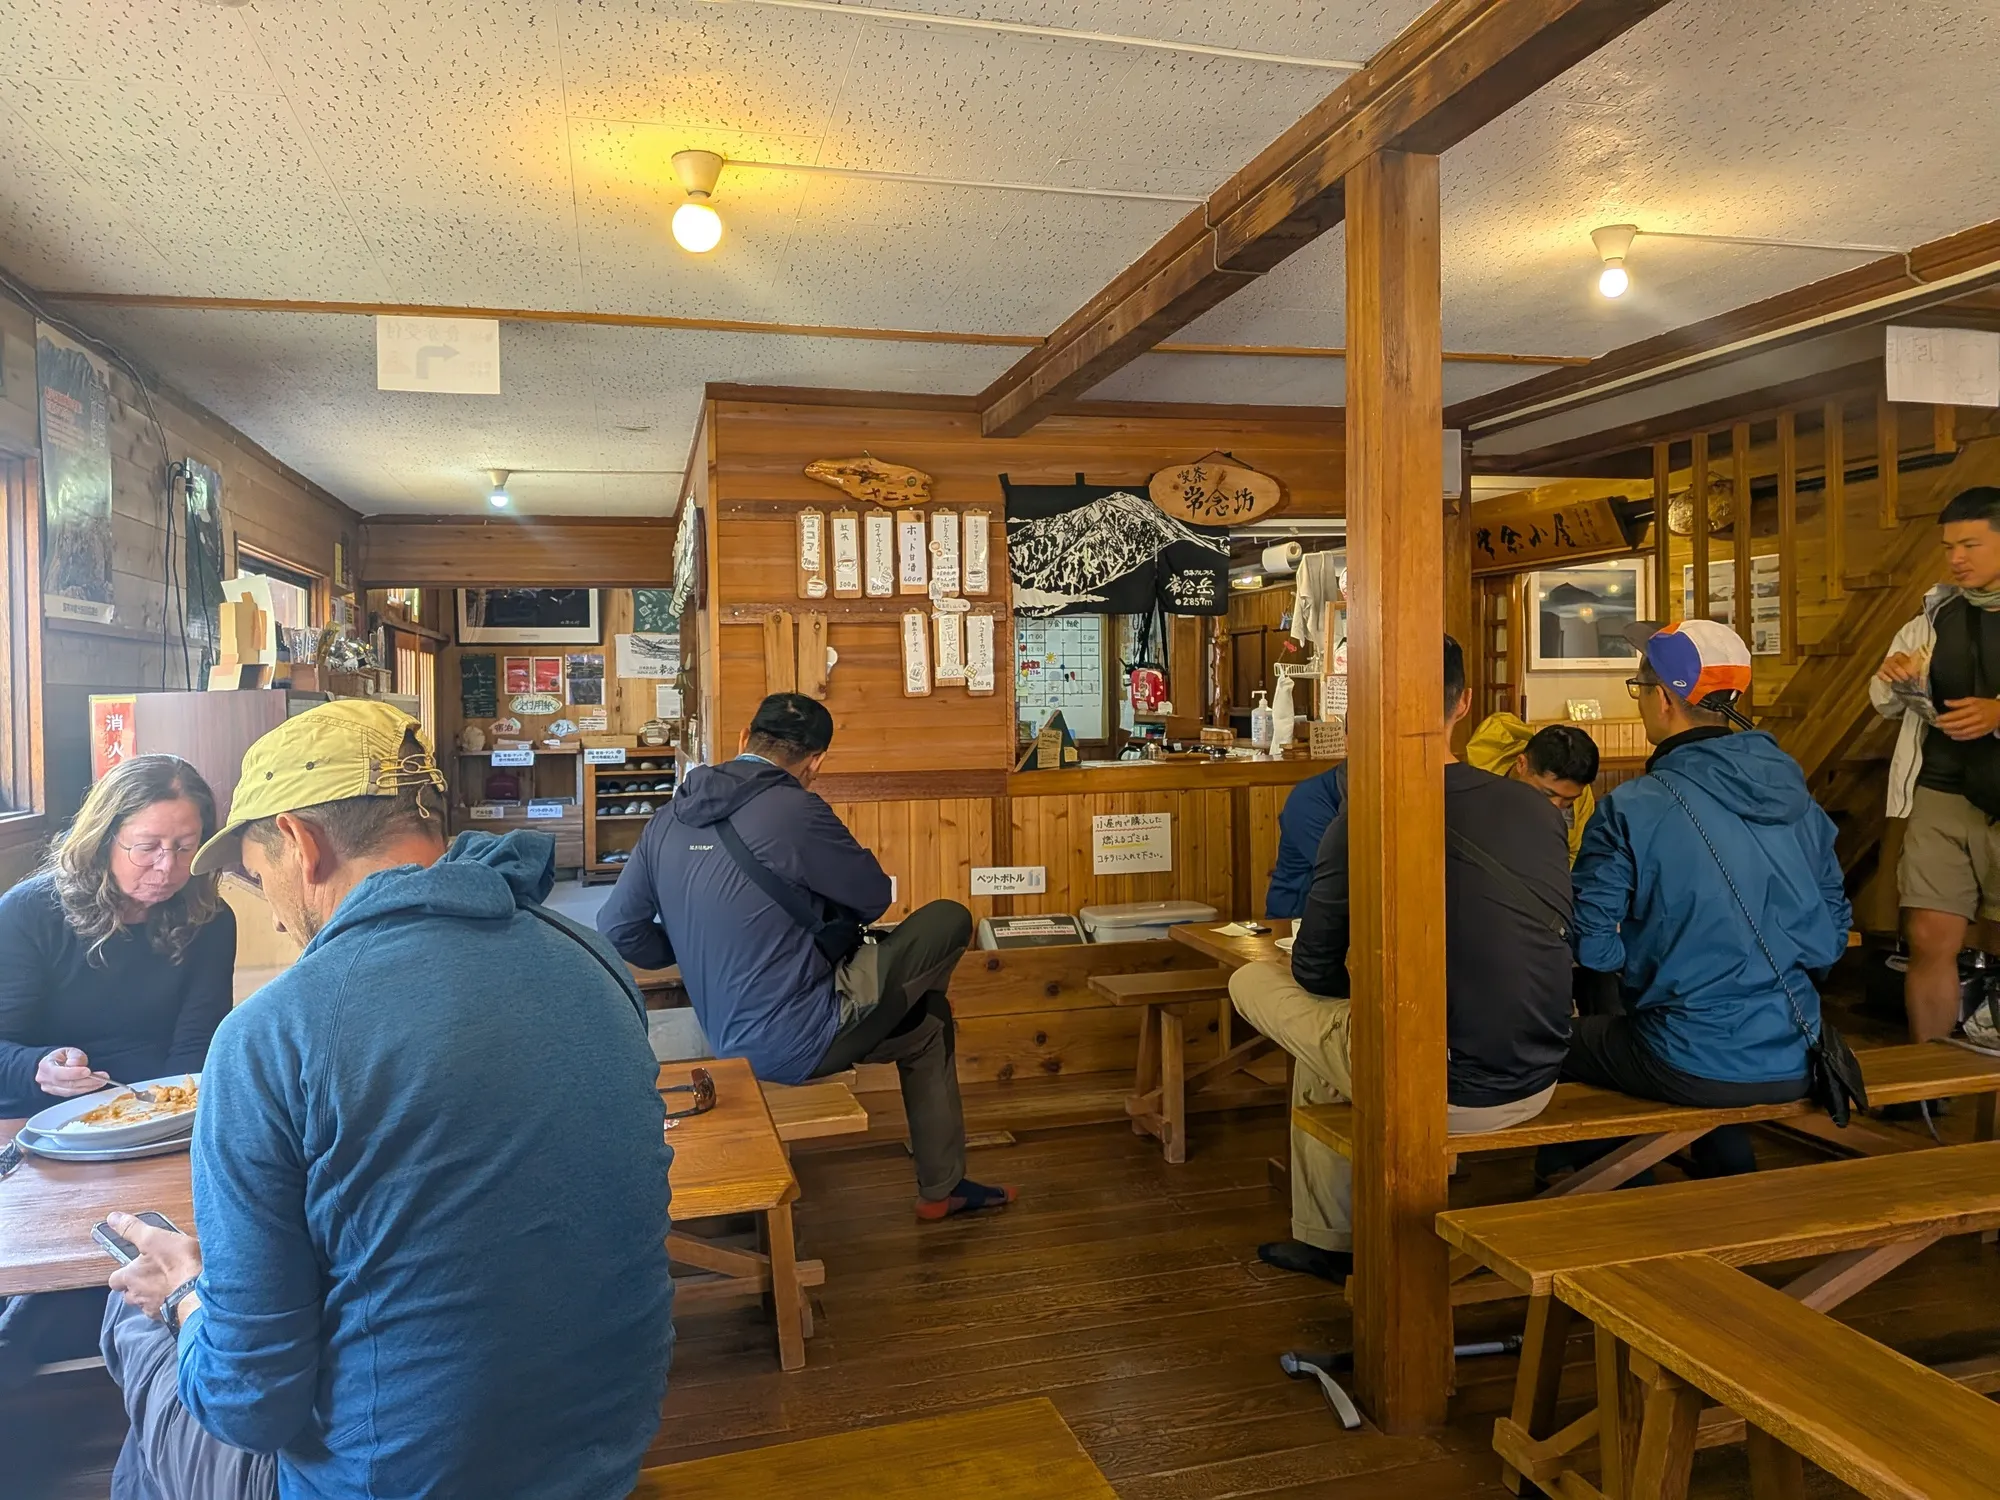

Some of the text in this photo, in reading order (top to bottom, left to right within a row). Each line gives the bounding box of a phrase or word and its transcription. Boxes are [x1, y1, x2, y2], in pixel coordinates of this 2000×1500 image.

[1177, 466, 1208, 484] 喫茶
[863, 488, 927, 501] メニュー
[1183, 485, 1254, 519] 常念坊
[806, 520, 815, 551] ココア
[840, 524, 850, 541] 紅茶
[906, 525, 917, 572] ホット甘酒
[871, 583, 890, 592] 600円
[1165, 574, 1215, 596] 常念岳
[972, 679, 991, 688] 600円
[494, 722, 513, 733] 宿泊
[554, 722, 572, 734] テント
[1096, 816, 1162, 828] 小屋内で購入した
[1102, 833, 1150, 846] 燃えるゴミは
[976, 873, 1025, 884] ペットボトル
